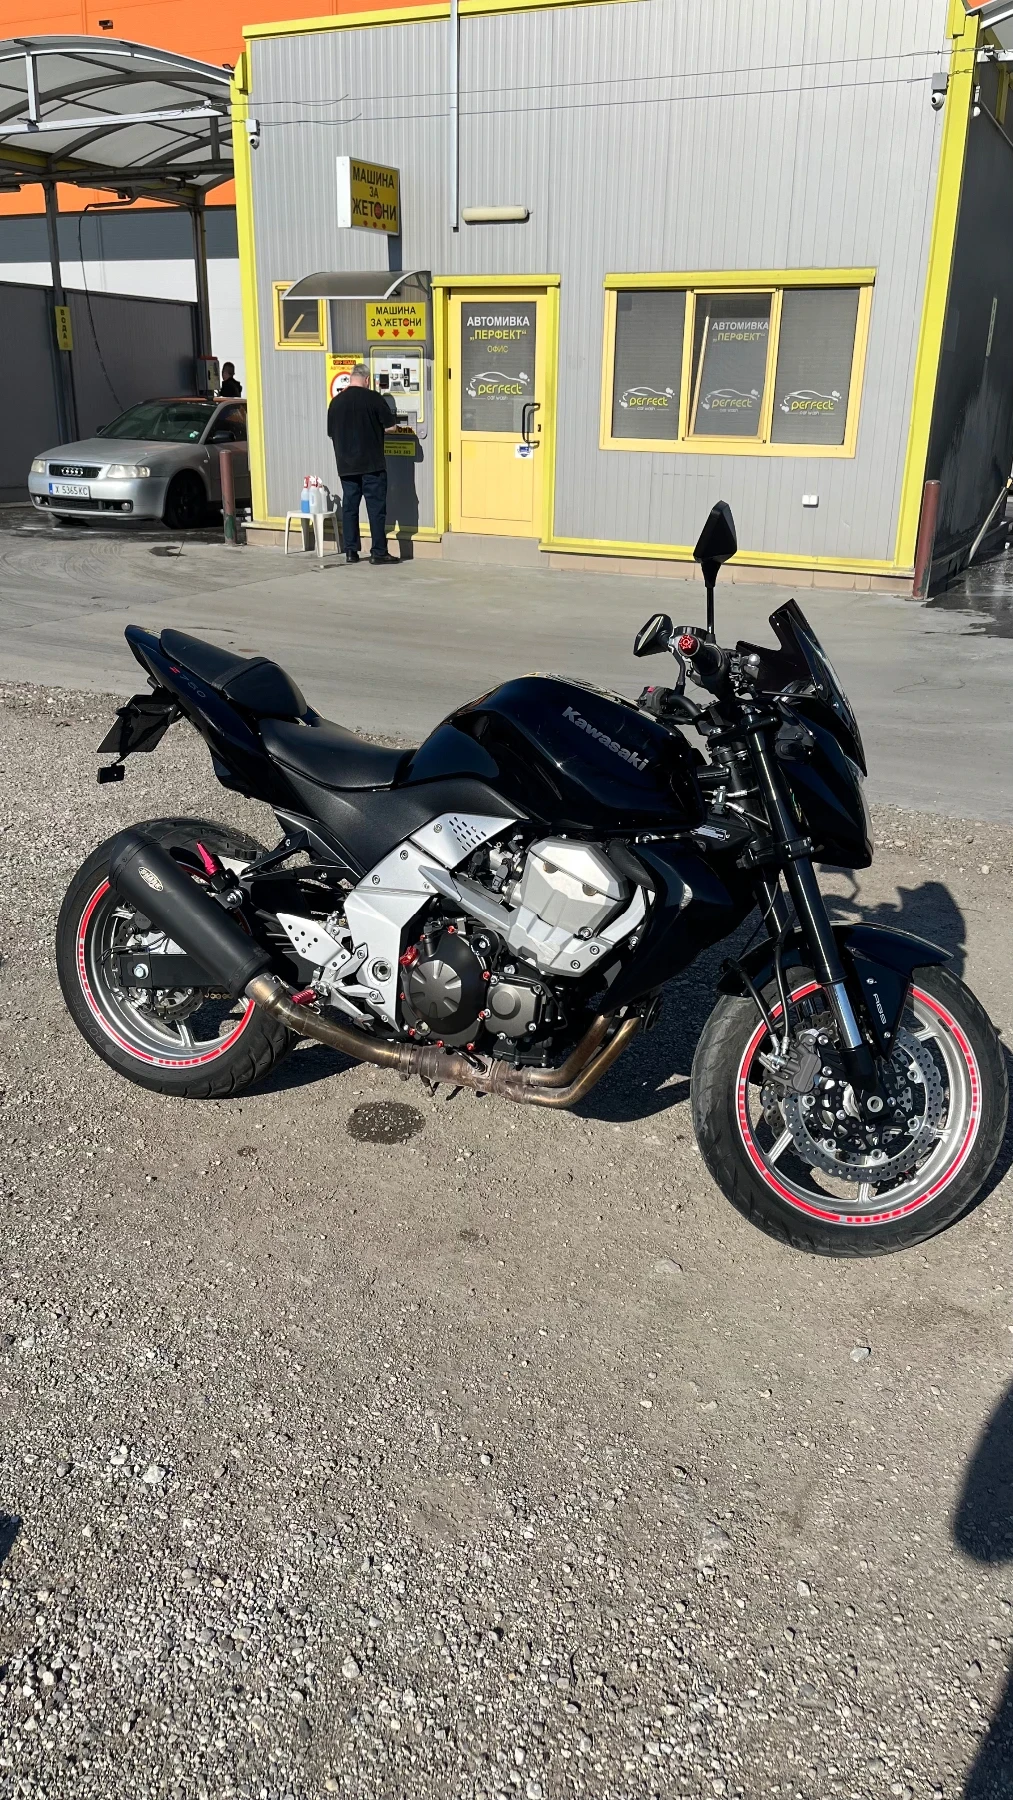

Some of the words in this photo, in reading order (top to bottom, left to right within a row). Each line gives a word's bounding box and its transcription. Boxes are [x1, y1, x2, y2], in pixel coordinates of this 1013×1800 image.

[353, 166, 395, 189] МАШИНА
[369, 186, 379, 198] ЗА
[352, 198, 397, 221] ЖЕТОНИ
[375, 306, 416, 315] МАШИНА
[370, 318, 382, 327] ЗА
[384, 317, 422, 327] ЖЕТОНИ
[467, 316, 530, 327] АВТОМИВКА
[712, 321, 769, 331] АВТОМИВКА
[487, 345, 509, 353] ОФИС
[478, 383, 523, 395] perfect
[629, 396, 669, 406] perfect
[791, 400, 834, 411] perfect
[562, 706, 650, 772] Kawasaki
